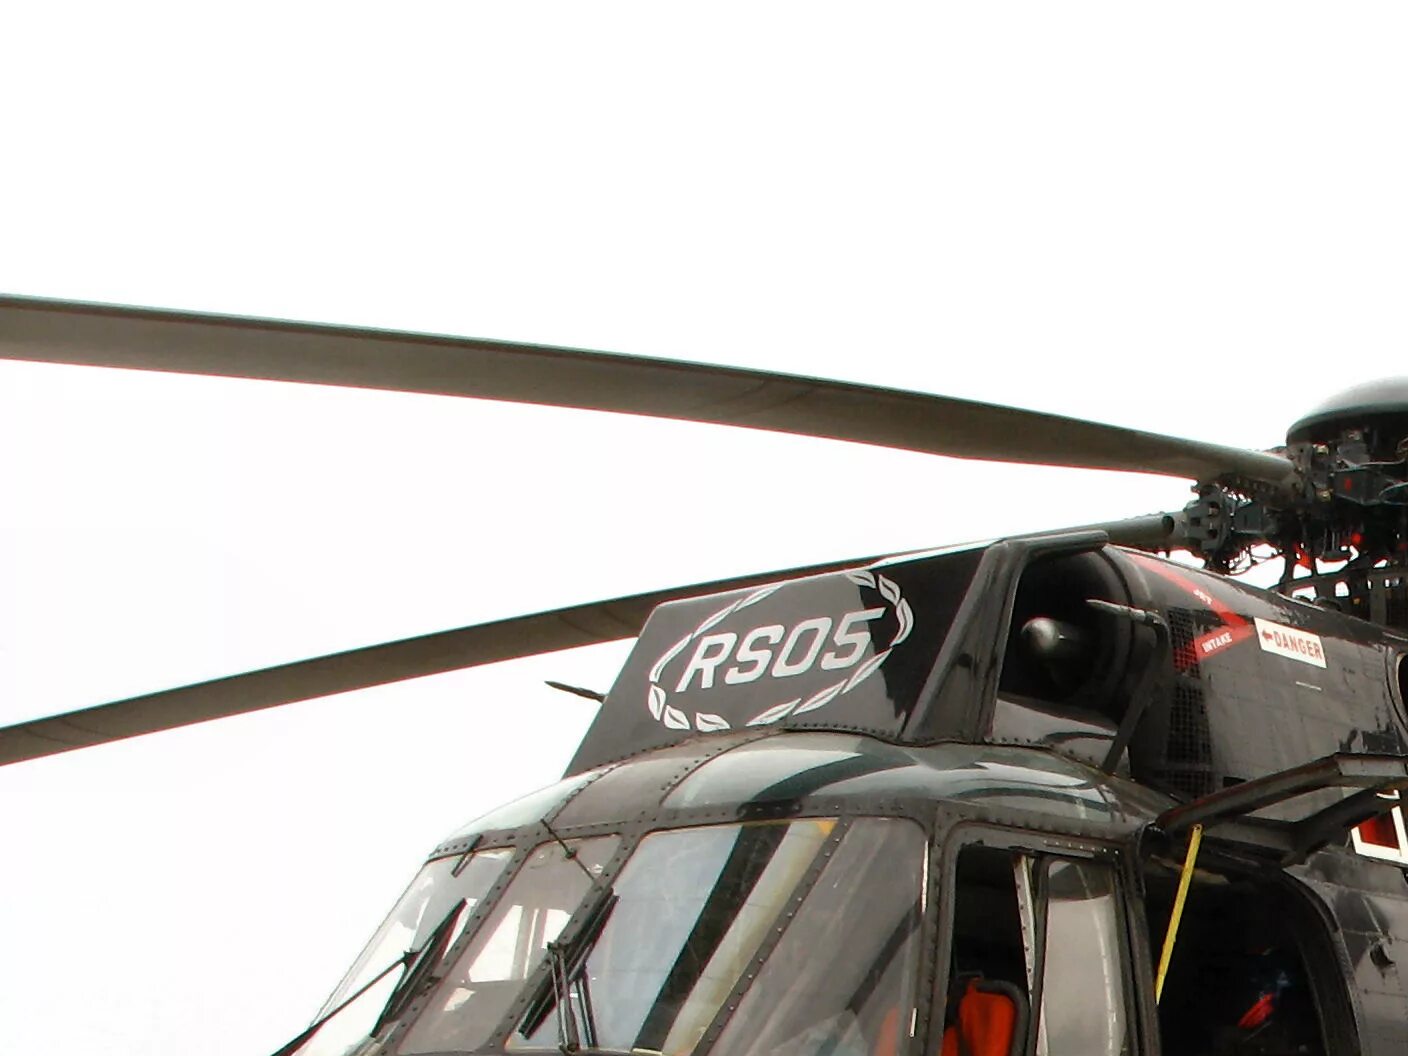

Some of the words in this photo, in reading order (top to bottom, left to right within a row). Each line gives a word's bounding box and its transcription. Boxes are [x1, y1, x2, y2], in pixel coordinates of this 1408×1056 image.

[674, 606, 887, 693] RS05
[1201, 631, 1233, 653] INTAKE
[1274, 630, 1323, 660] DANGER
